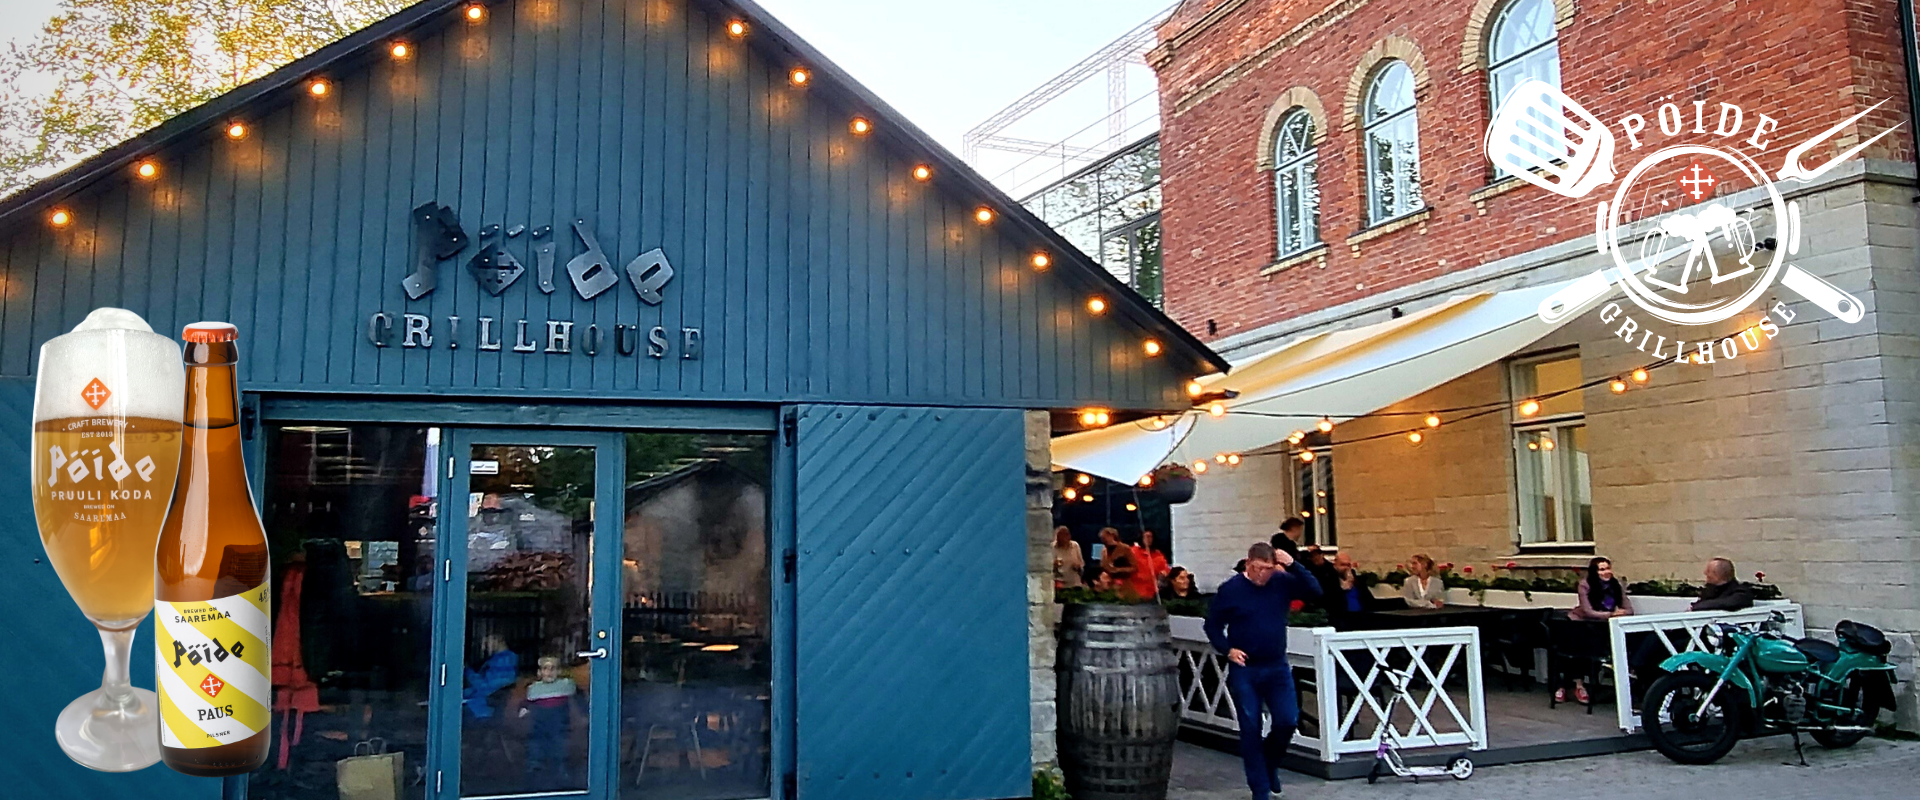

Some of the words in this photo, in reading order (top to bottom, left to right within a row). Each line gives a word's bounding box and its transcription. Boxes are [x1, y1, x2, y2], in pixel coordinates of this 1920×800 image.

[368, 311, 702, 361] GRILLHOUSE
[68, 419, 90, 431] CRAFT
[91, 418, 129, 429] BREWERY
[81, 431, 94, 439] EST
[51, 489, 102, 501] PRUULI
[110, 489, 152, 501] KODA
[73, 511, 127, 523] SAAREMAA
[174, 610, 232, 624] SAAREMAA
[197, 704, 234, 722] PAUS
[206, 730, 231, 739] PILSNER
